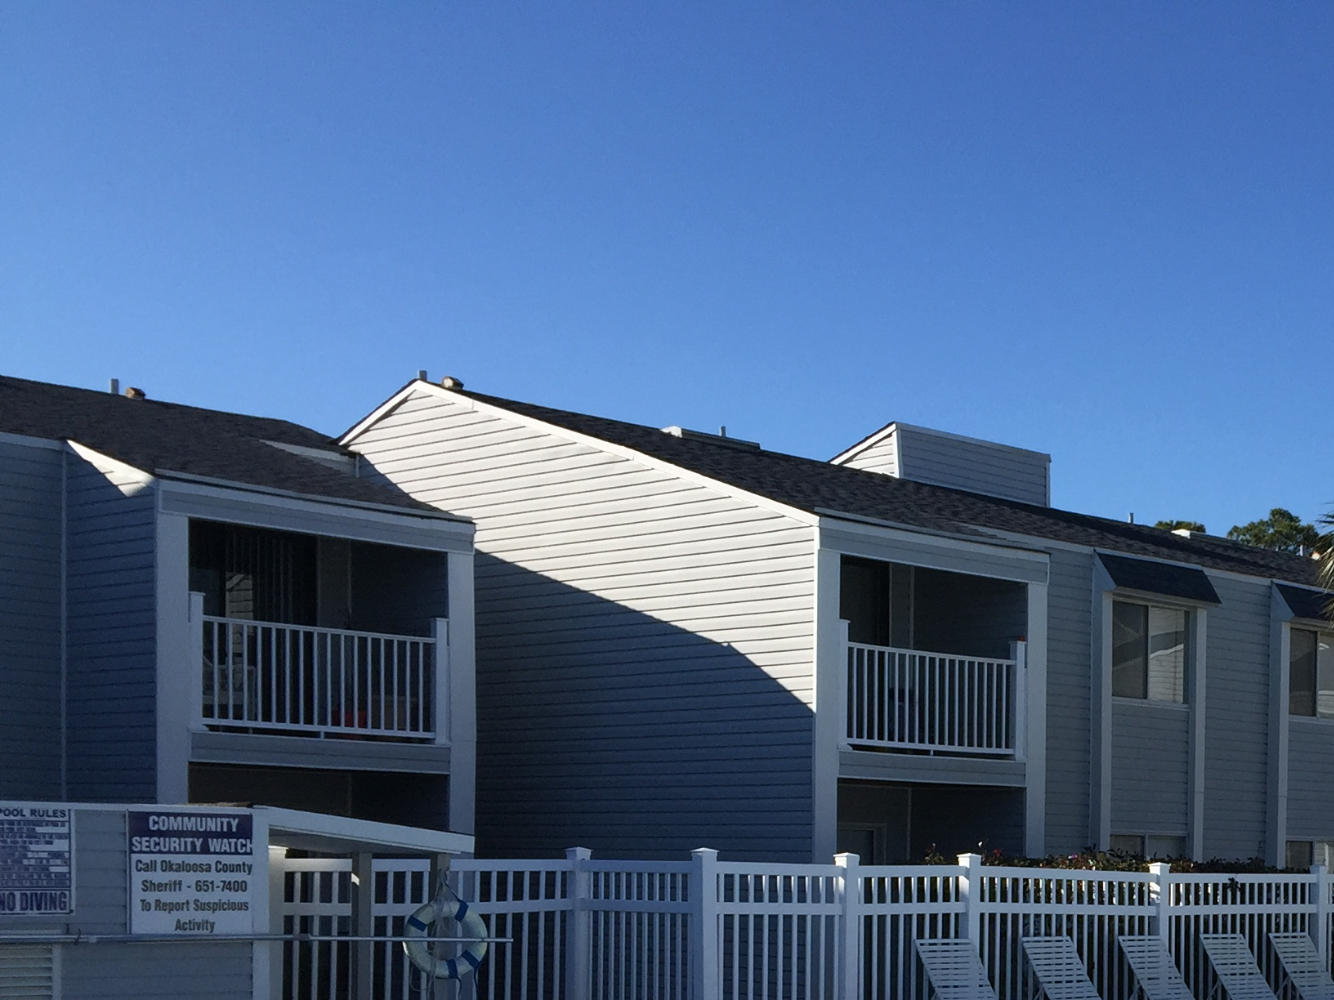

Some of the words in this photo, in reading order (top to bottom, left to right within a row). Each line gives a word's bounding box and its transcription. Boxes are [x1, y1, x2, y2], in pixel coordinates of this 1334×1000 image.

[30, 809, 67, 818] RULES
[148, 815, 239, 832] COMMUNITY
[131, 836, 204, 852] SECURITY
[135, 859, 157, 873] Call
[160, 860, 212, 873] Okaloosa
[215, 861, 253, 875] County
[141, 879, 183, 893] Sheriff
[195, 880, 248, 893] 651-7400
[20, 892, 68, 911] DIVING
[140, 899, 152, 911] To
[154, 899, 190, 914] Report
[193, 900, 249, 914] Suspicious
[174, 919, 216, 933] Activity
